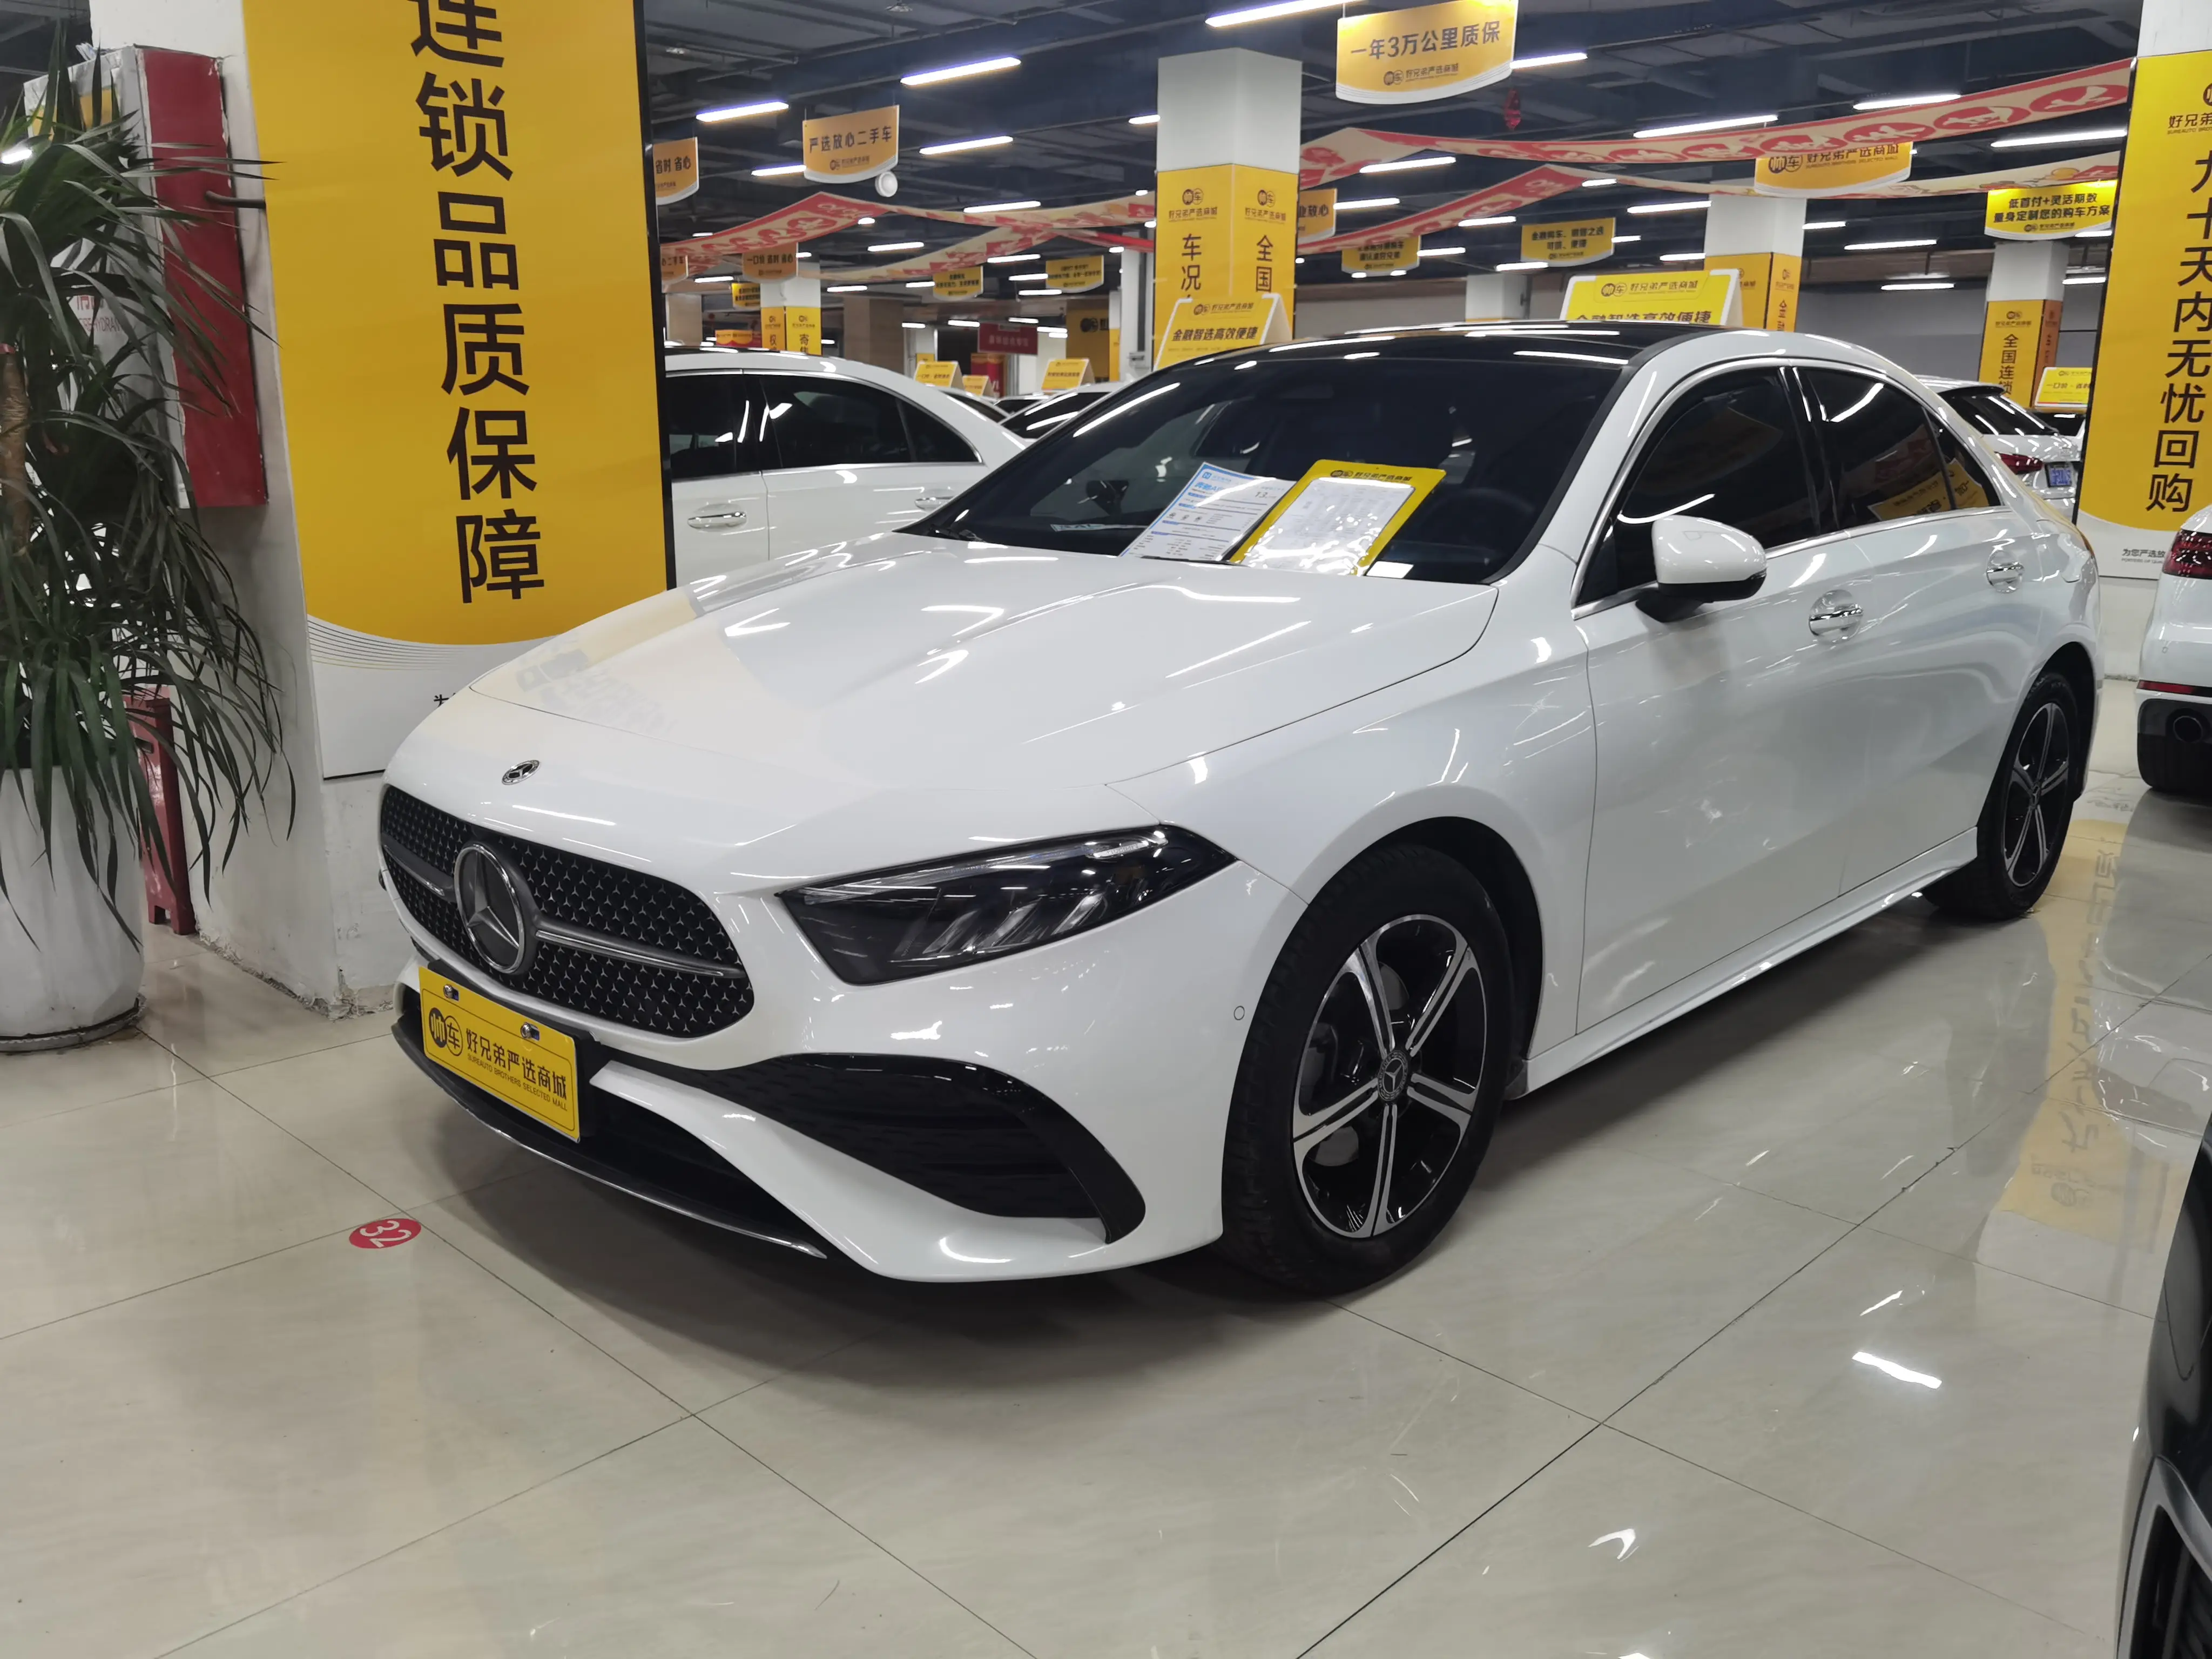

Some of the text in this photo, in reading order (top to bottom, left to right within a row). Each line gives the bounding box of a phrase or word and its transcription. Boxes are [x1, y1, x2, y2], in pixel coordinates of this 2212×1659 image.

[1351, 21, 1501, 59] 一年3万公里质保
[2168, 112, 2212, 129] 好兄弟
[809, 126, 892, 153] 严选放心二手车
[1994, 205, 2110, 222] 量身定制您的购车方案
[2009, 193, 2098, 209] 低首付+灵活期数
[1181, 233, 1202, 298] 车况
[1256, 234, 1273, 292] 全国
[410, 0, 544, 604] 连锁品质保障
[1172, 327, 1259, 341] 金融智选高效便捷
[466, 1028, 567, 1100] 好兄弟严选商城
[468, 1053, 568, 1112] SUREAUTO BROTHERS SELECTED MALL
[359, 1220, 412, 1247] 32
